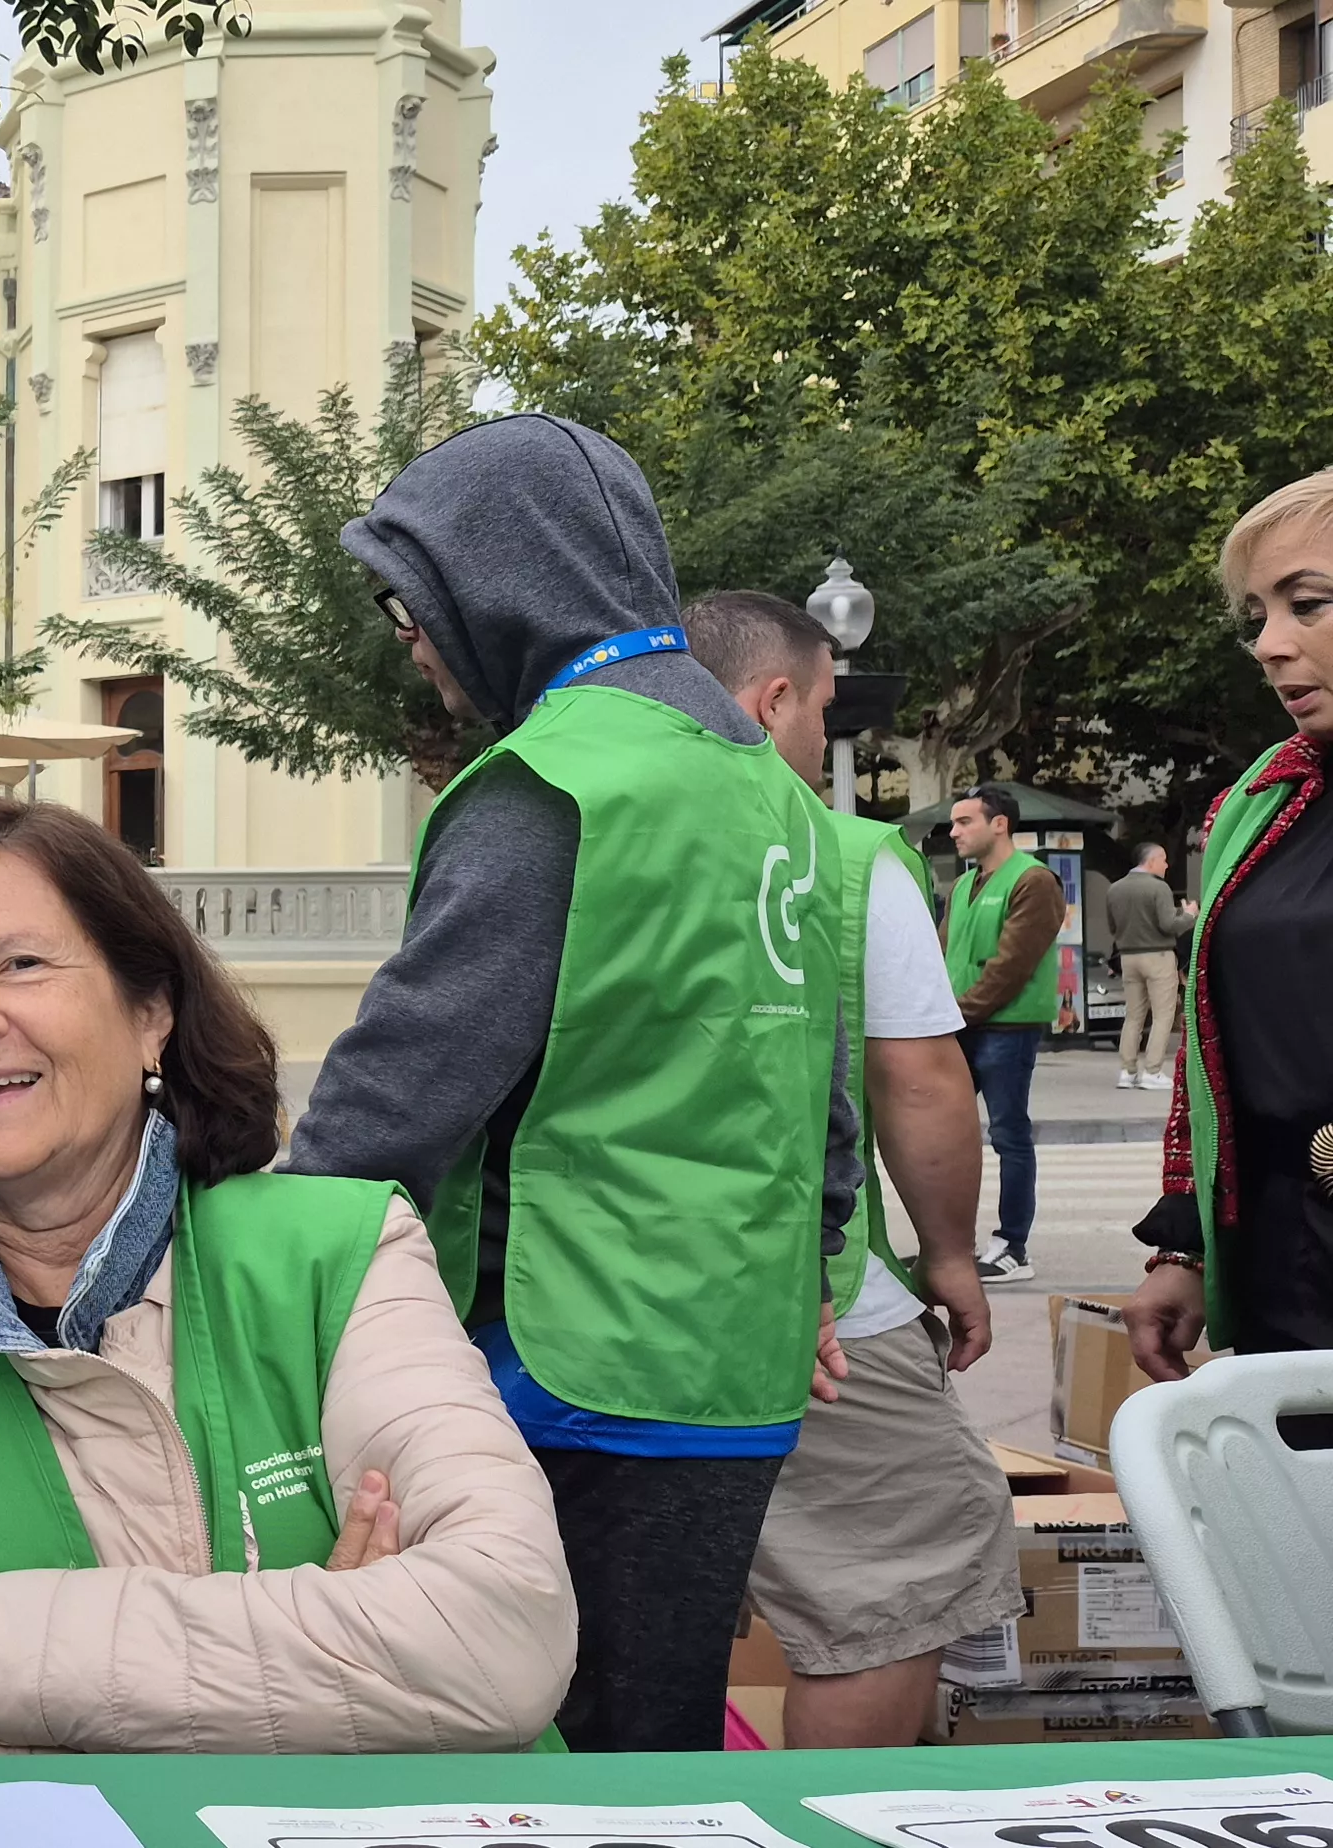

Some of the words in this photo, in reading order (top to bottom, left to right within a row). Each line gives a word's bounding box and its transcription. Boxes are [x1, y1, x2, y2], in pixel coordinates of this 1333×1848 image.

[573, 645, 620, 673] DOWN
[251, 1468, 294, 1490] contra
[257, 1492, 275, 1505] en
